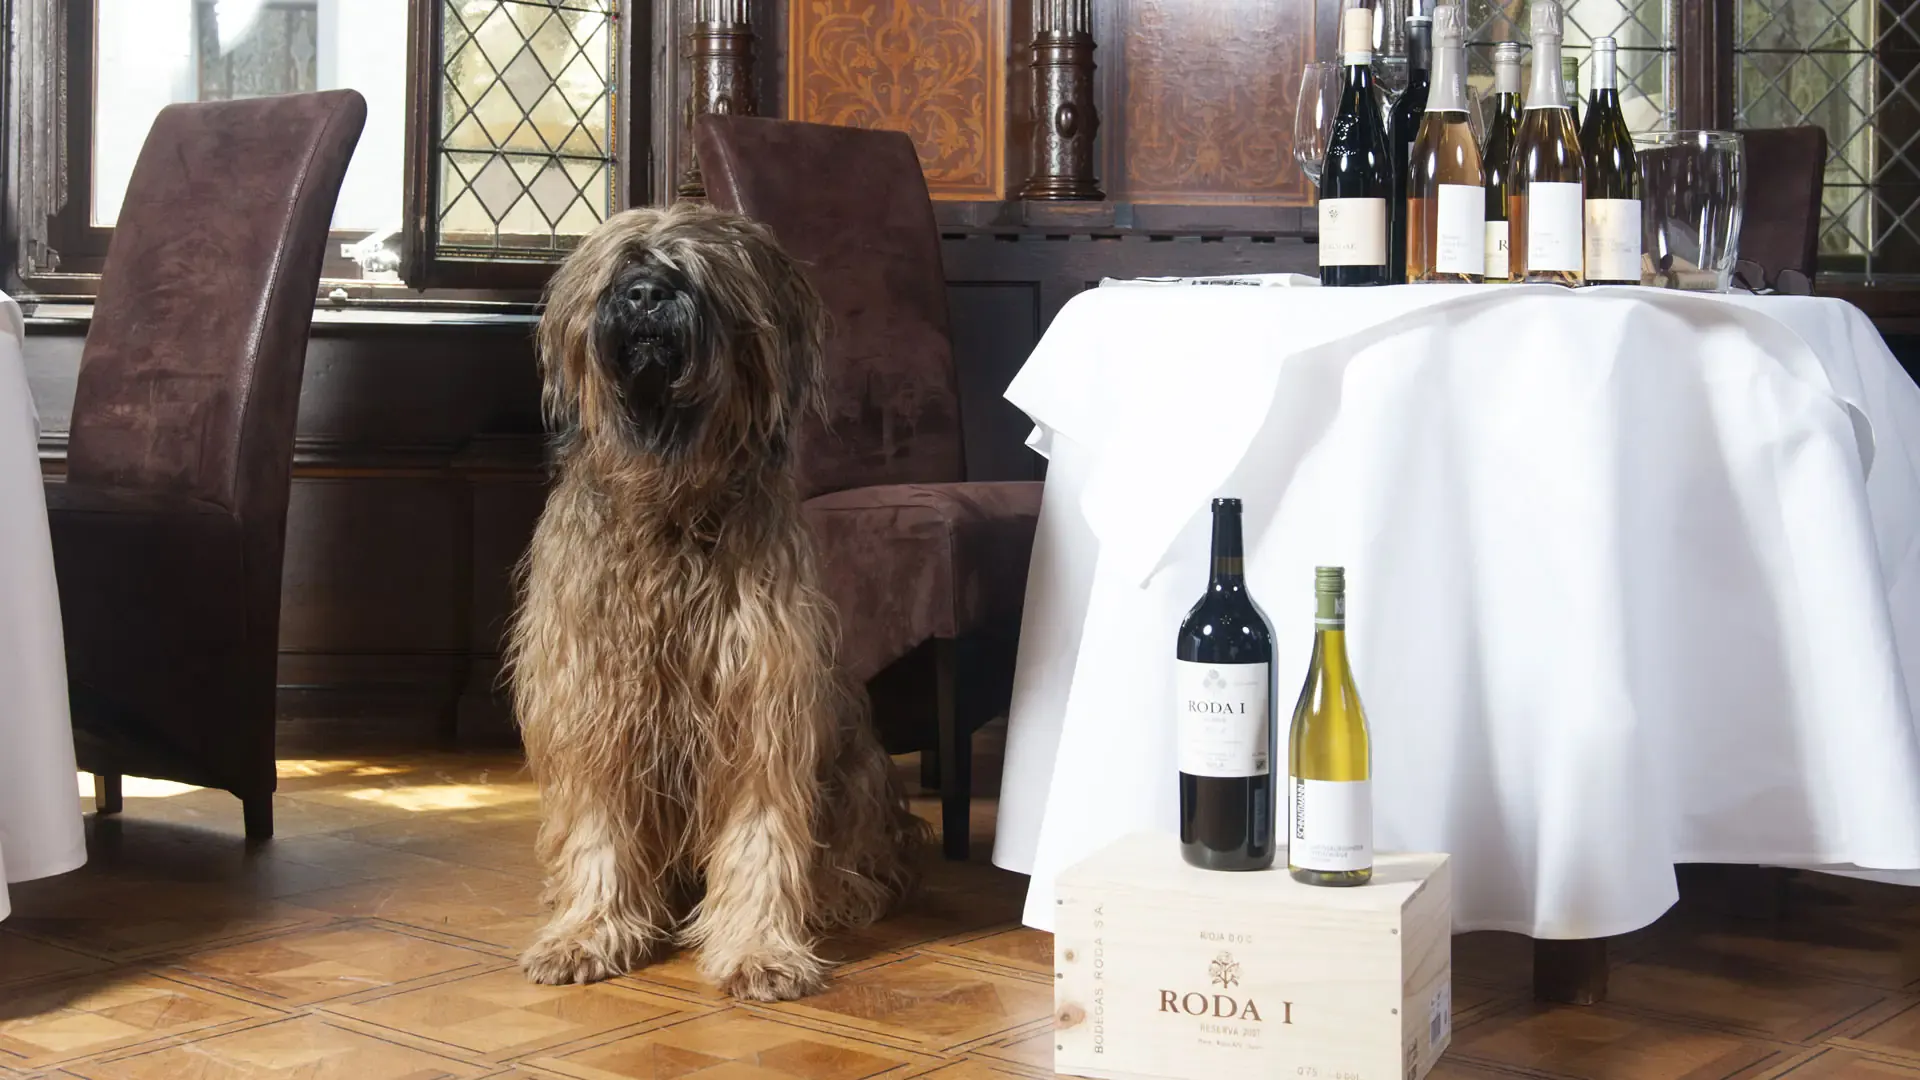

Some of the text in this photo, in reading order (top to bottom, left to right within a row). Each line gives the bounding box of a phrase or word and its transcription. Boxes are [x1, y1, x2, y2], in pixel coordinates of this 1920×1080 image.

[1189, 700, 1245, 714] RODA I
[1093, 938, 1104, 981] RODA
[1093, 987, 1104, 1055] BODEGAS
[1158, 988, 1293, 1024] RODA I
[1199, 1022, 1239, 1036] RESERVA
